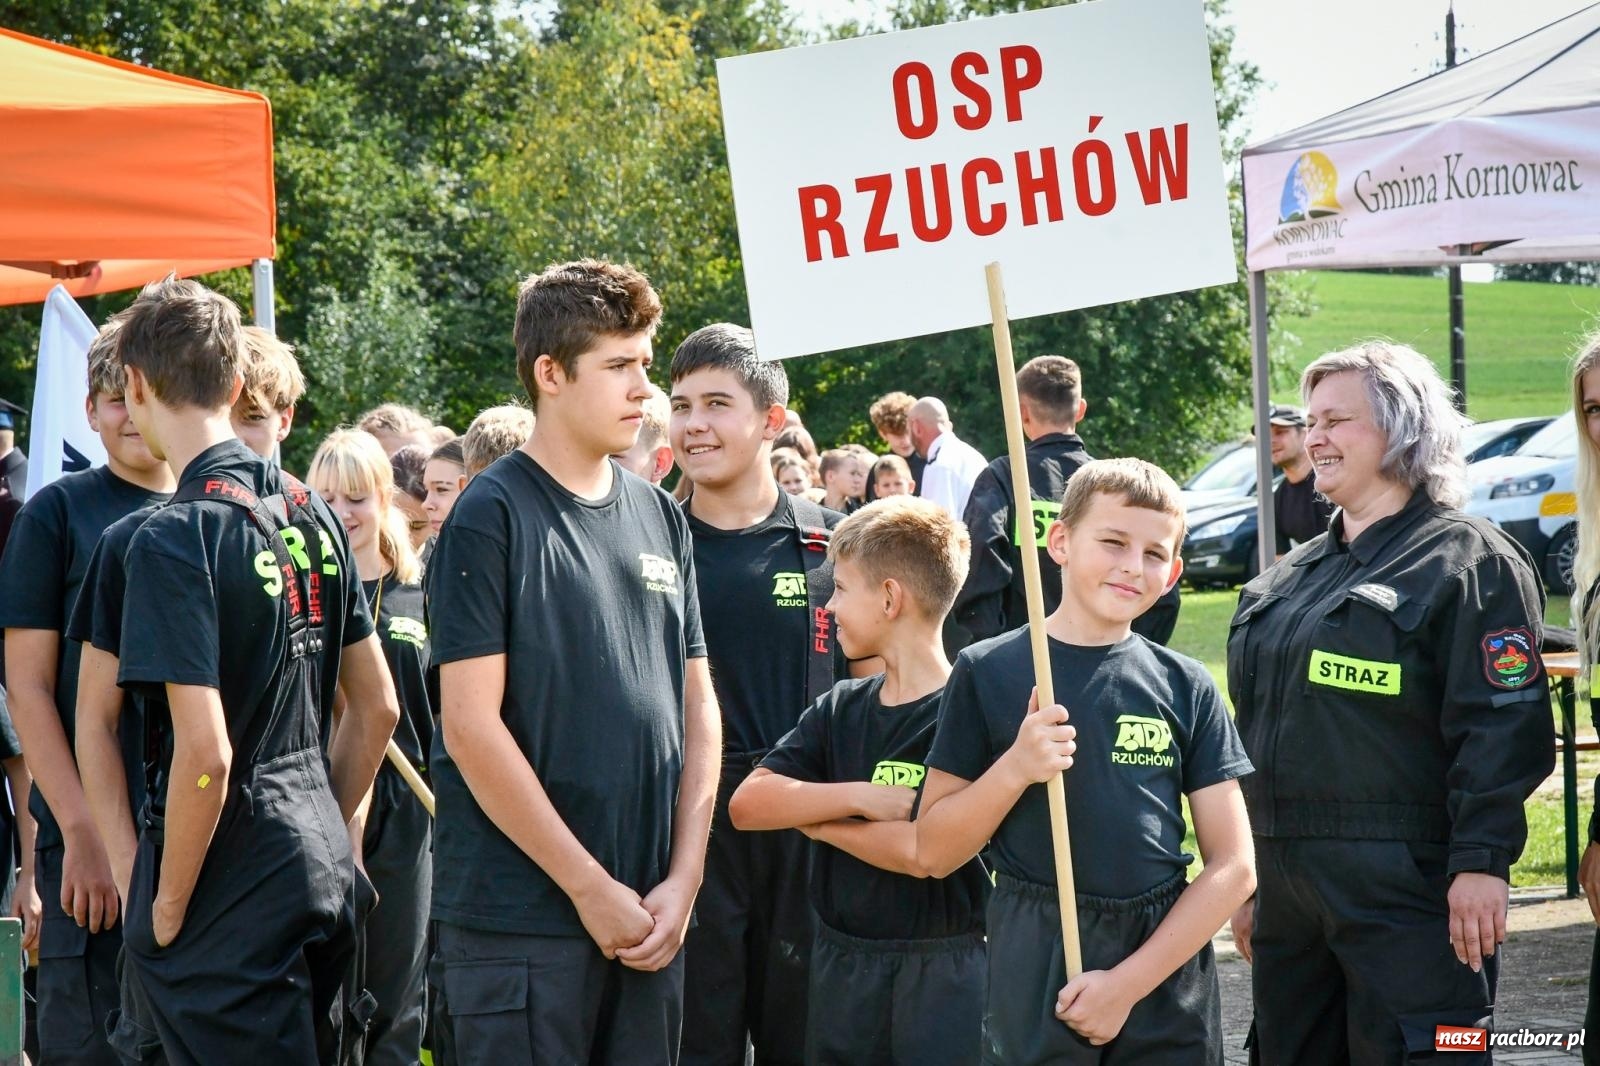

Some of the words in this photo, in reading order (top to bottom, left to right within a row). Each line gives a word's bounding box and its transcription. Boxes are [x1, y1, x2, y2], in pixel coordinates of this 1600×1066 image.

[893, 44, 1043, 140] OSP
[798, 115, 1189, 263] RZUCHÓW
[1354, 167, 1438, 214] Gmina
[1444, 152, 1583, 201] Kornowac
[281, 563, 301, 617] FHR
[309, 573, 323, 624] FHR
[776, 598, 808, 607] RZUCH
[815, 606, 830, 654] FHR
[1111, 751, 1174, 768] RZUCHÓW
